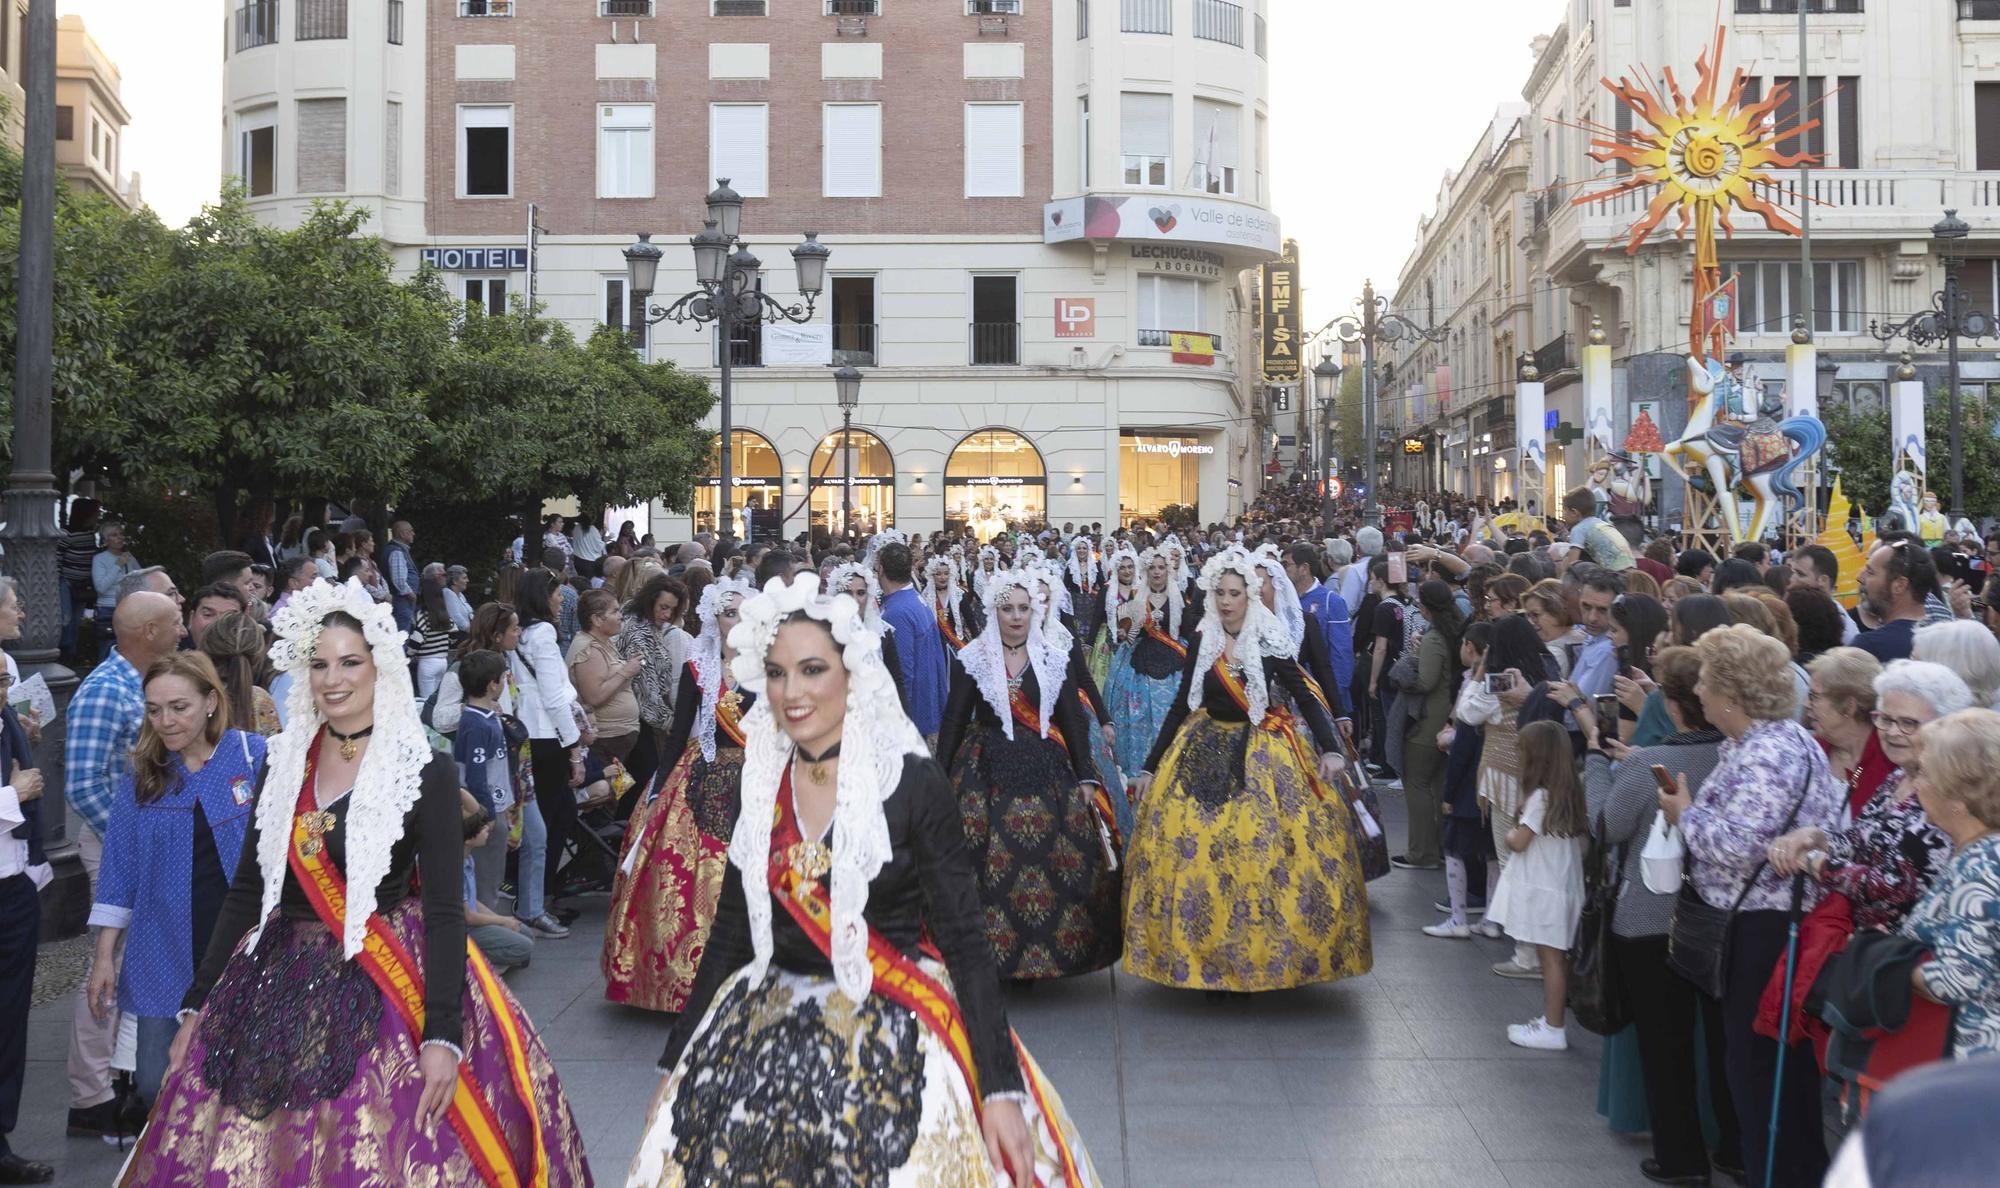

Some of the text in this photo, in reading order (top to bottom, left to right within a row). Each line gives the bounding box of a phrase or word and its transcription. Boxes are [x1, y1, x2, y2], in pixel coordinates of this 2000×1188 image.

[1190, 207, 1224, 224] Valle
[1227, 212, 1243, 227] de
[422, 249, 526, 269] HOTEL
[1154, 261, 1219, 276] ABOGADOS
[1271, 271, 1292, 356] EMFISA
[1137, 444, 1168, 453] ALVARO
[1180, 445, 1214, 454] MORENO
[473, 747, 486, 764] 3
